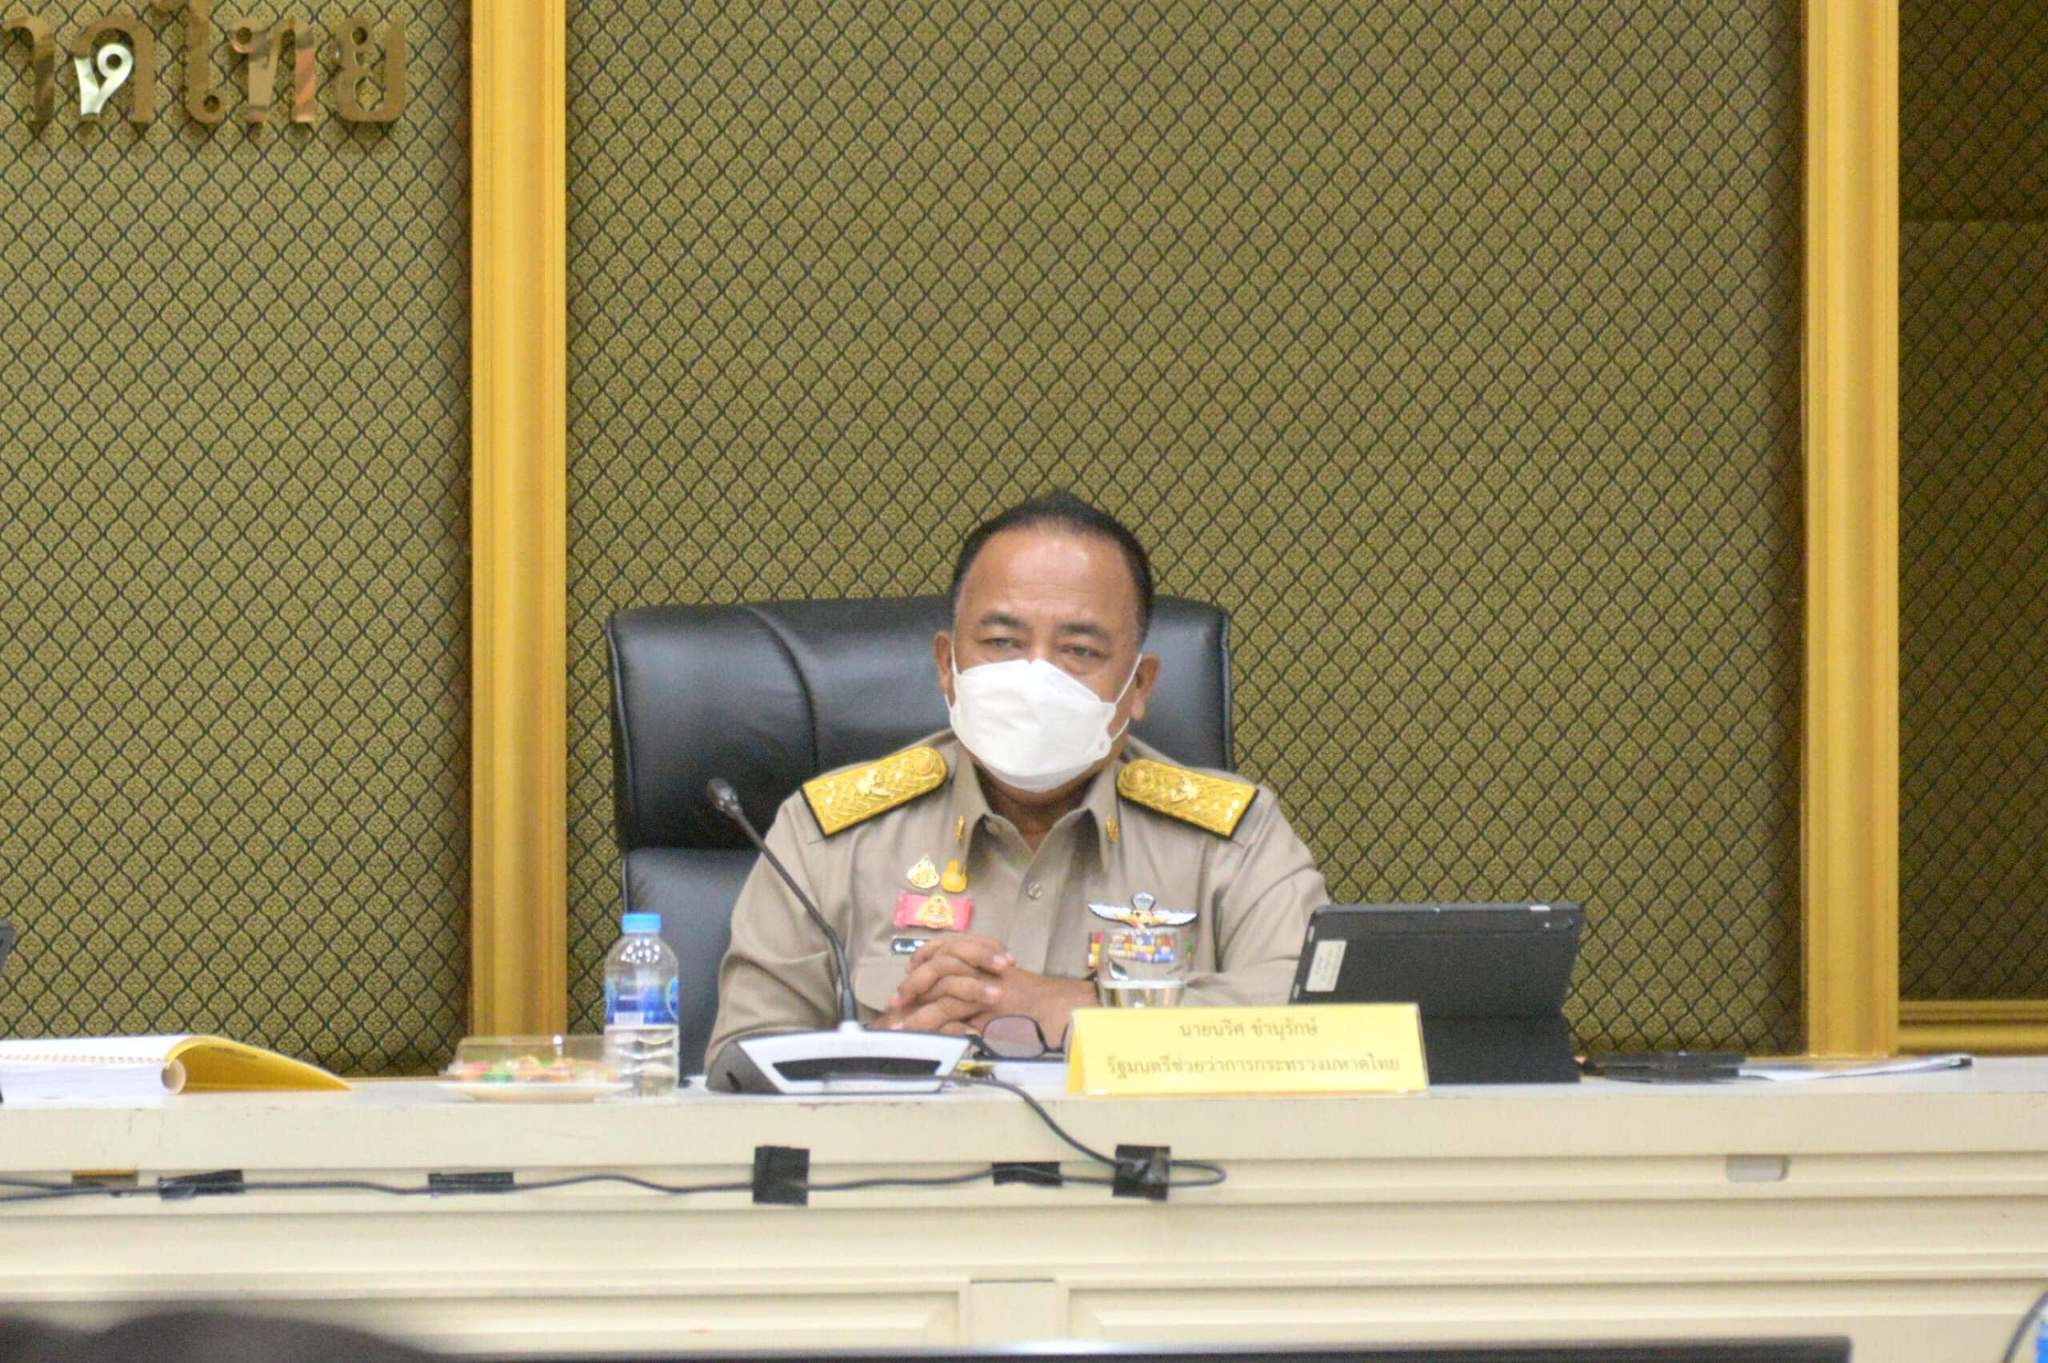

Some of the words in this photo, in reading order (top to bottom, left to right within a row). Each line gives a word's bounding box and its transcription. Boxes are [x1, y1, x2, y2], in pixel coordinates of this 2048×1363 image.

[1107, 1053, 1400, 1079] รัฐมนตรีช่วยว่าการกระทรวงมหาดไทย
